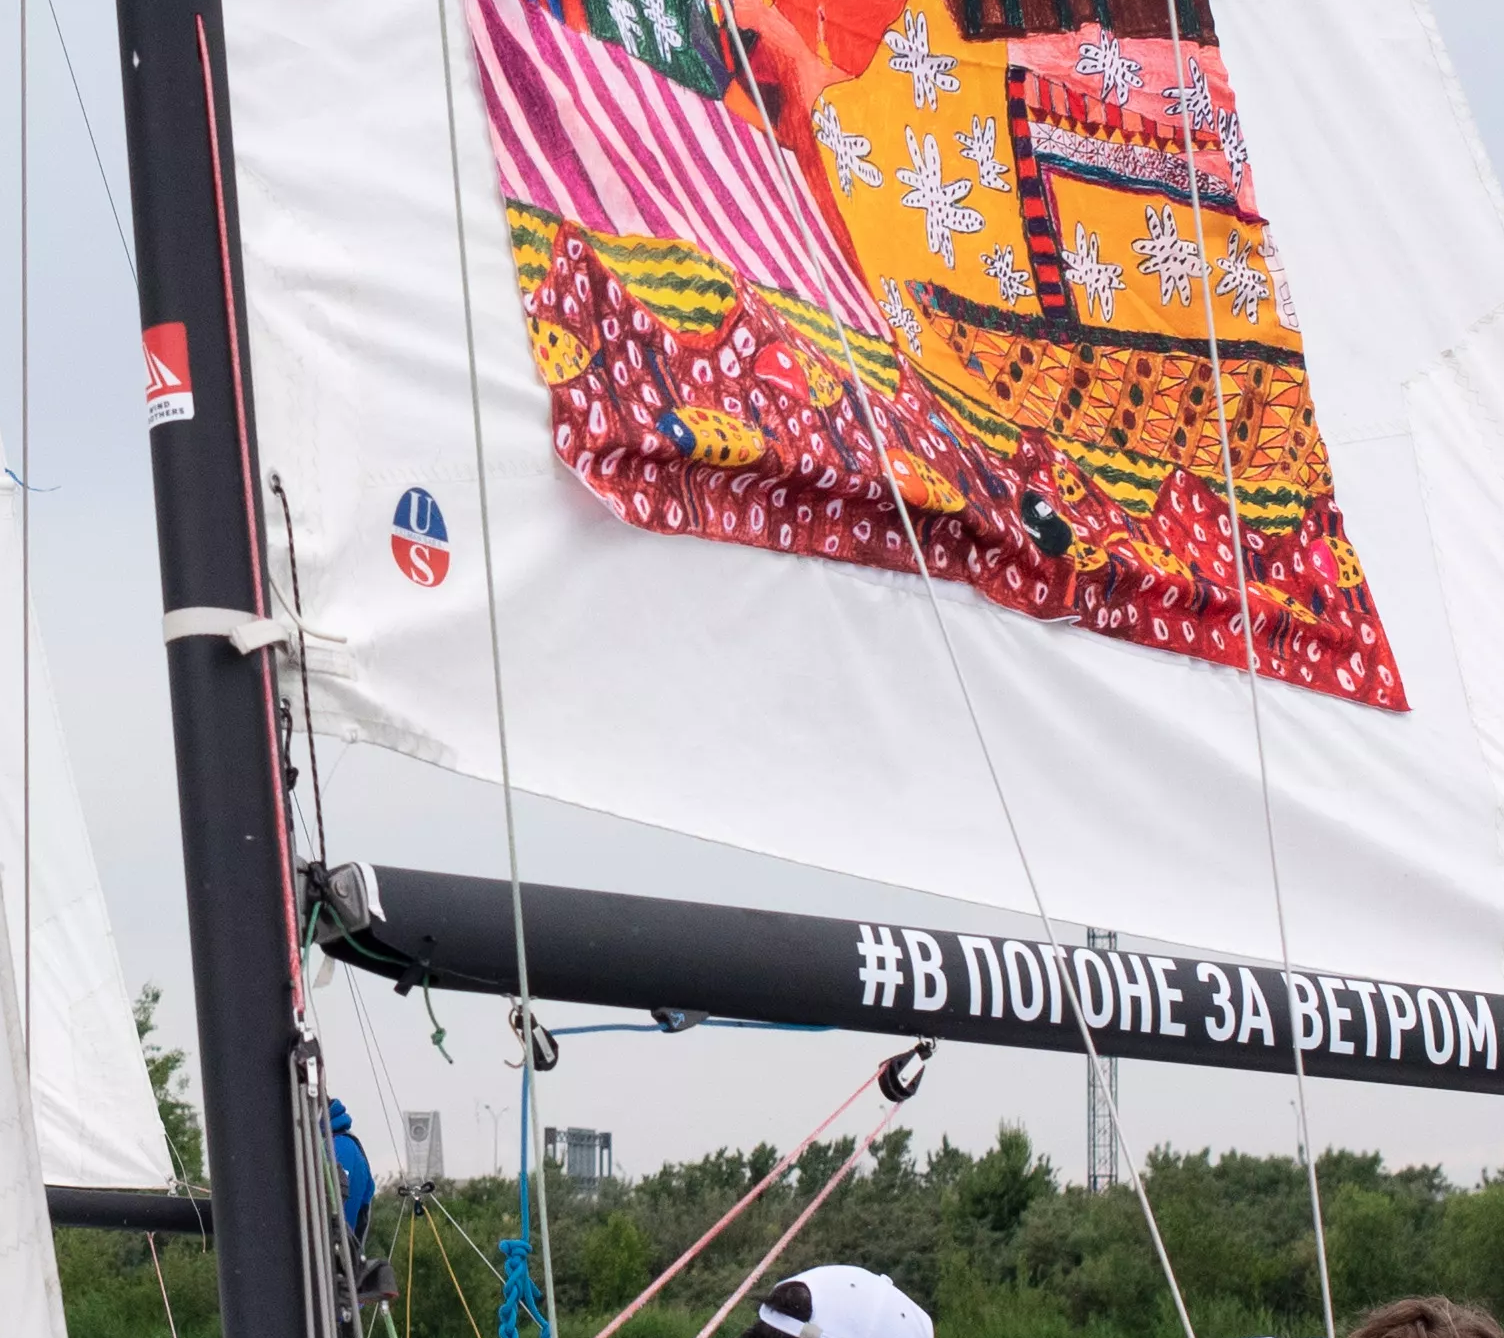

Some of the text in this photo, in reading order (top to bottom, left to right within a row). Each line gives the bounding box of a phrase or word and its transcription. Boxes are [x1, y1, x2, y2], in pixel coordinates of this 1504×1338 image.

[857, 924, 1498, 1070] #В ПОГОНЕ ЗА ВЕТРОМ
